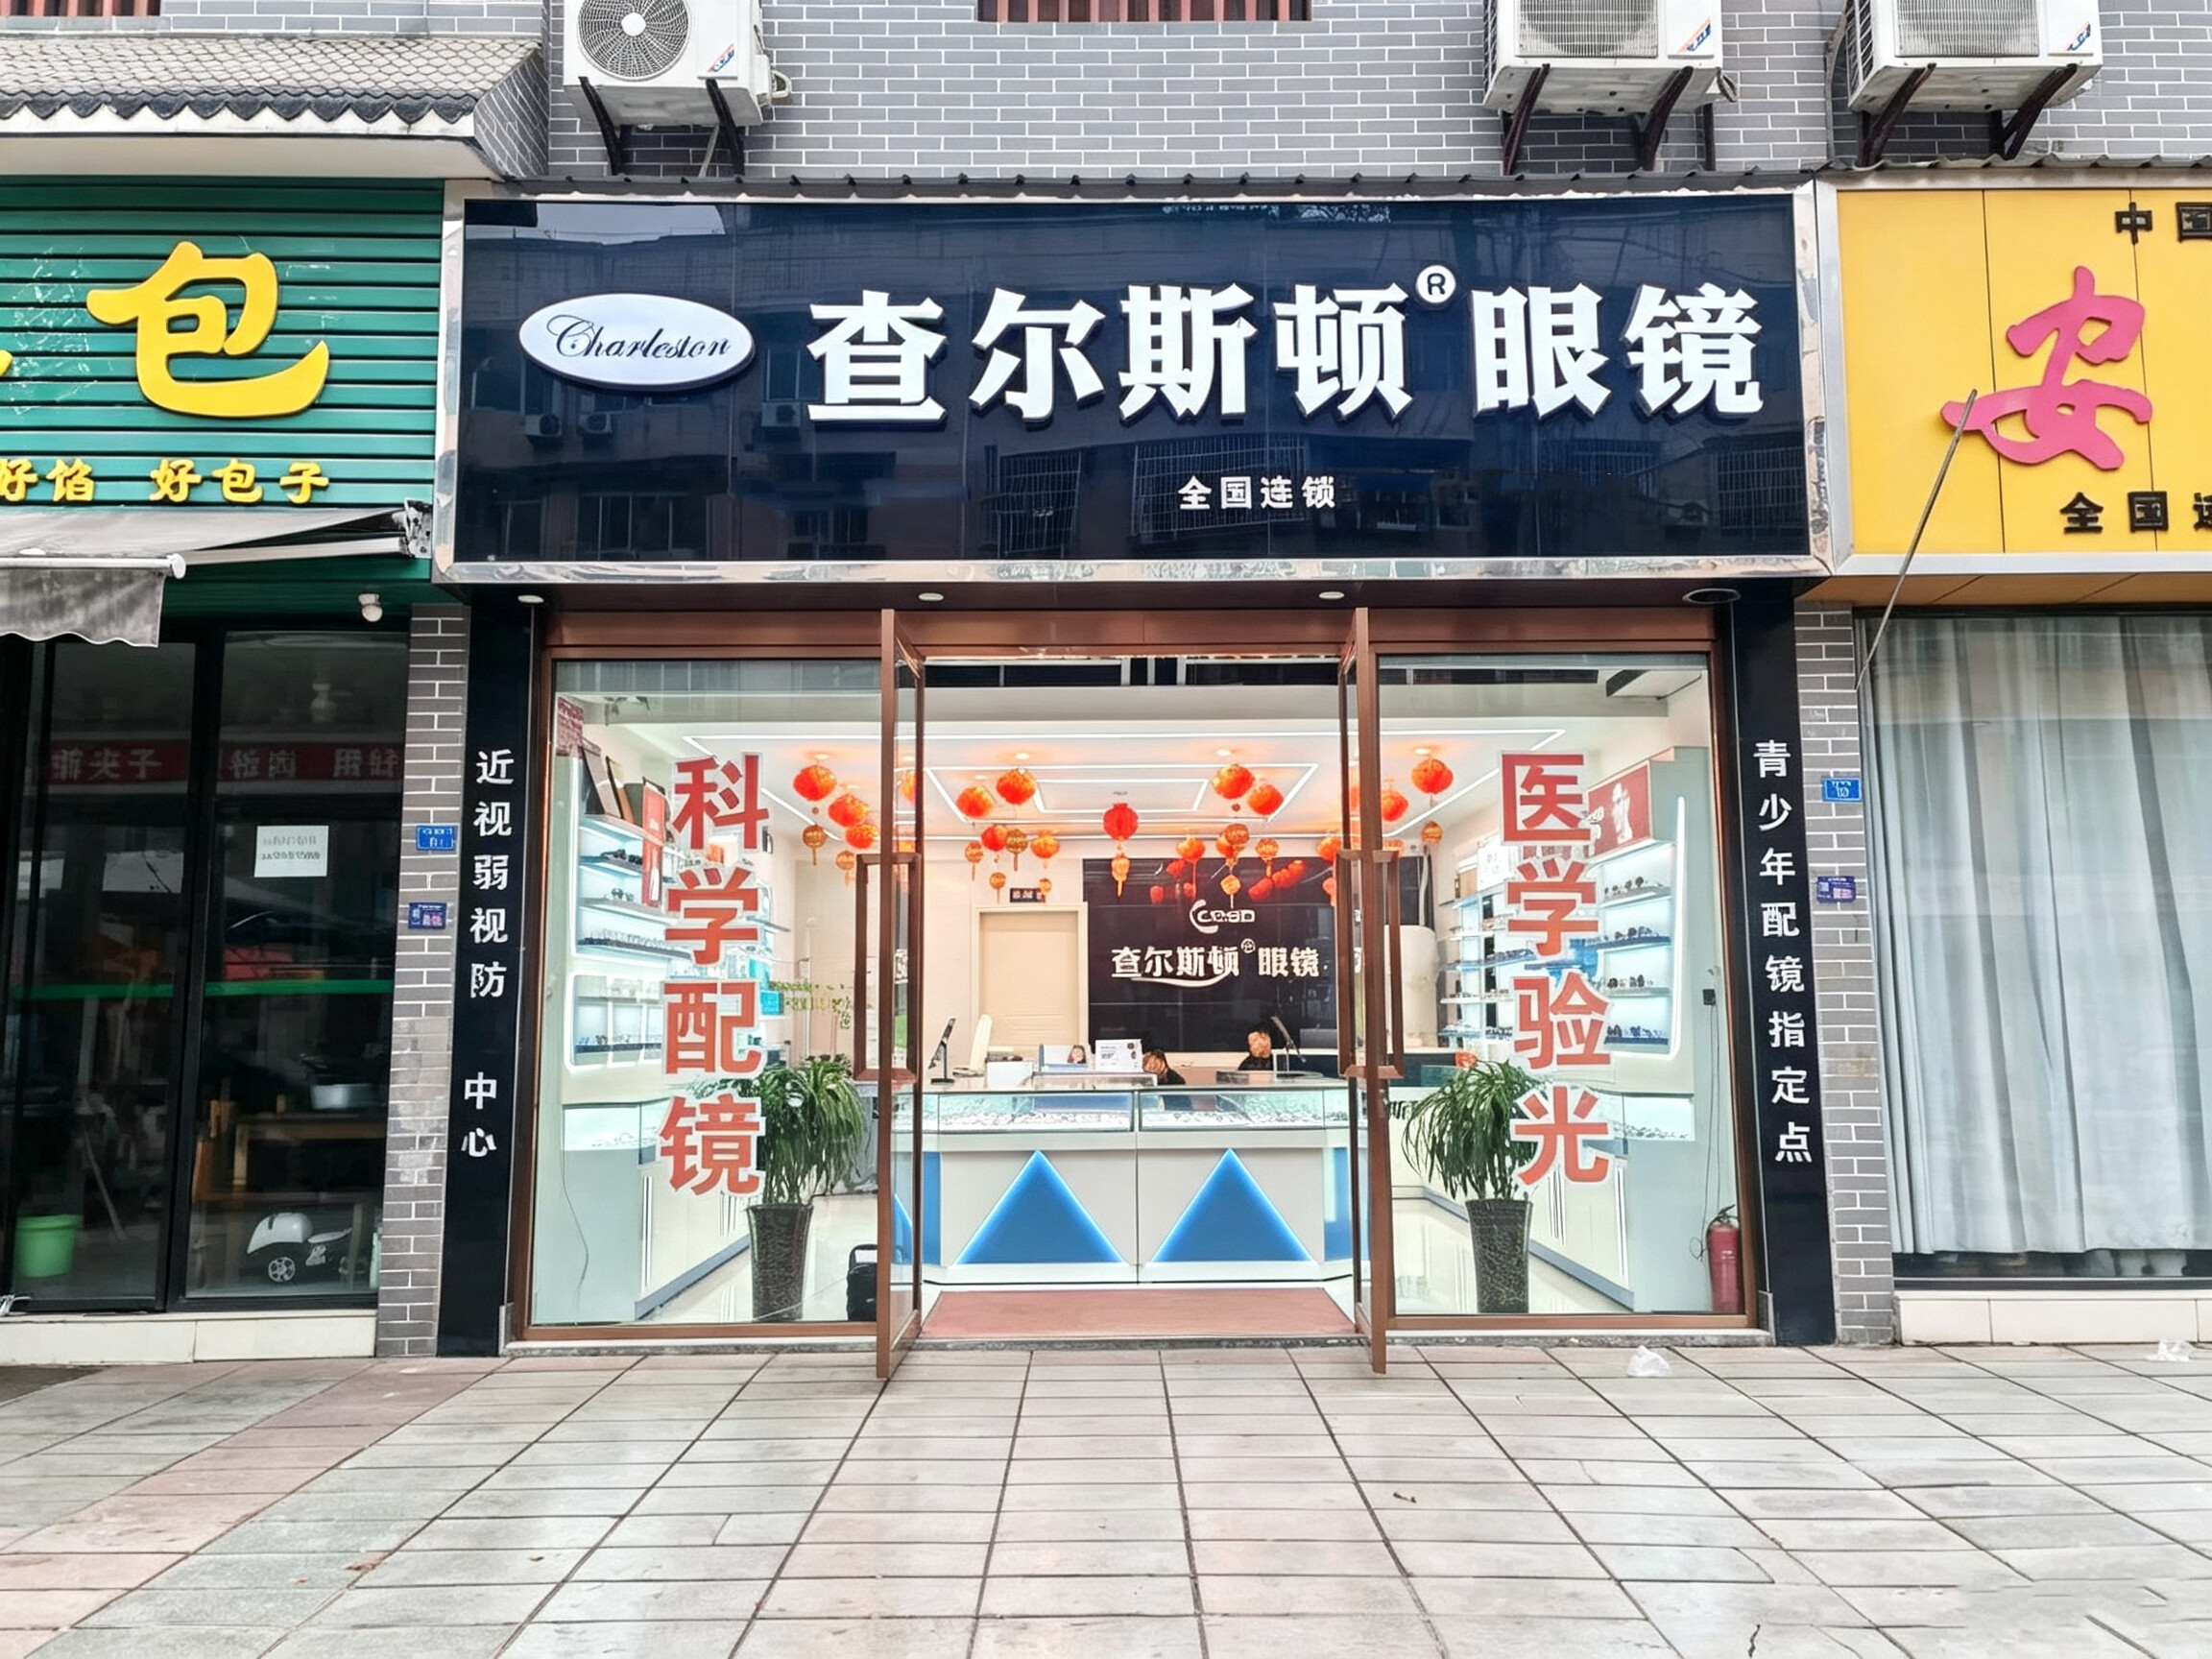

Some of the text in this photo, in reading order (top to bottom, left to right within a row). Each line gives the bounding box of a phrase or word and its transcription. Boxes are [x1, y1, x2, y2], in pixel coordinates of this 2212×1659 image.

[86, 241, 330, 419] 包
[546, 314, 731, 359] Charleston
[1941, 265, 2153, 471] 安
[0, 458, 330, 504] 好馅 好包子
[1177, 474, 1336, 511] 全国连锁
[660, 752, 770, 1197] 科学配镜
[1501, 753, 1612, 1187] 医学验光
[1753, 739, 1813, 1164] 青少年配镜指定点
